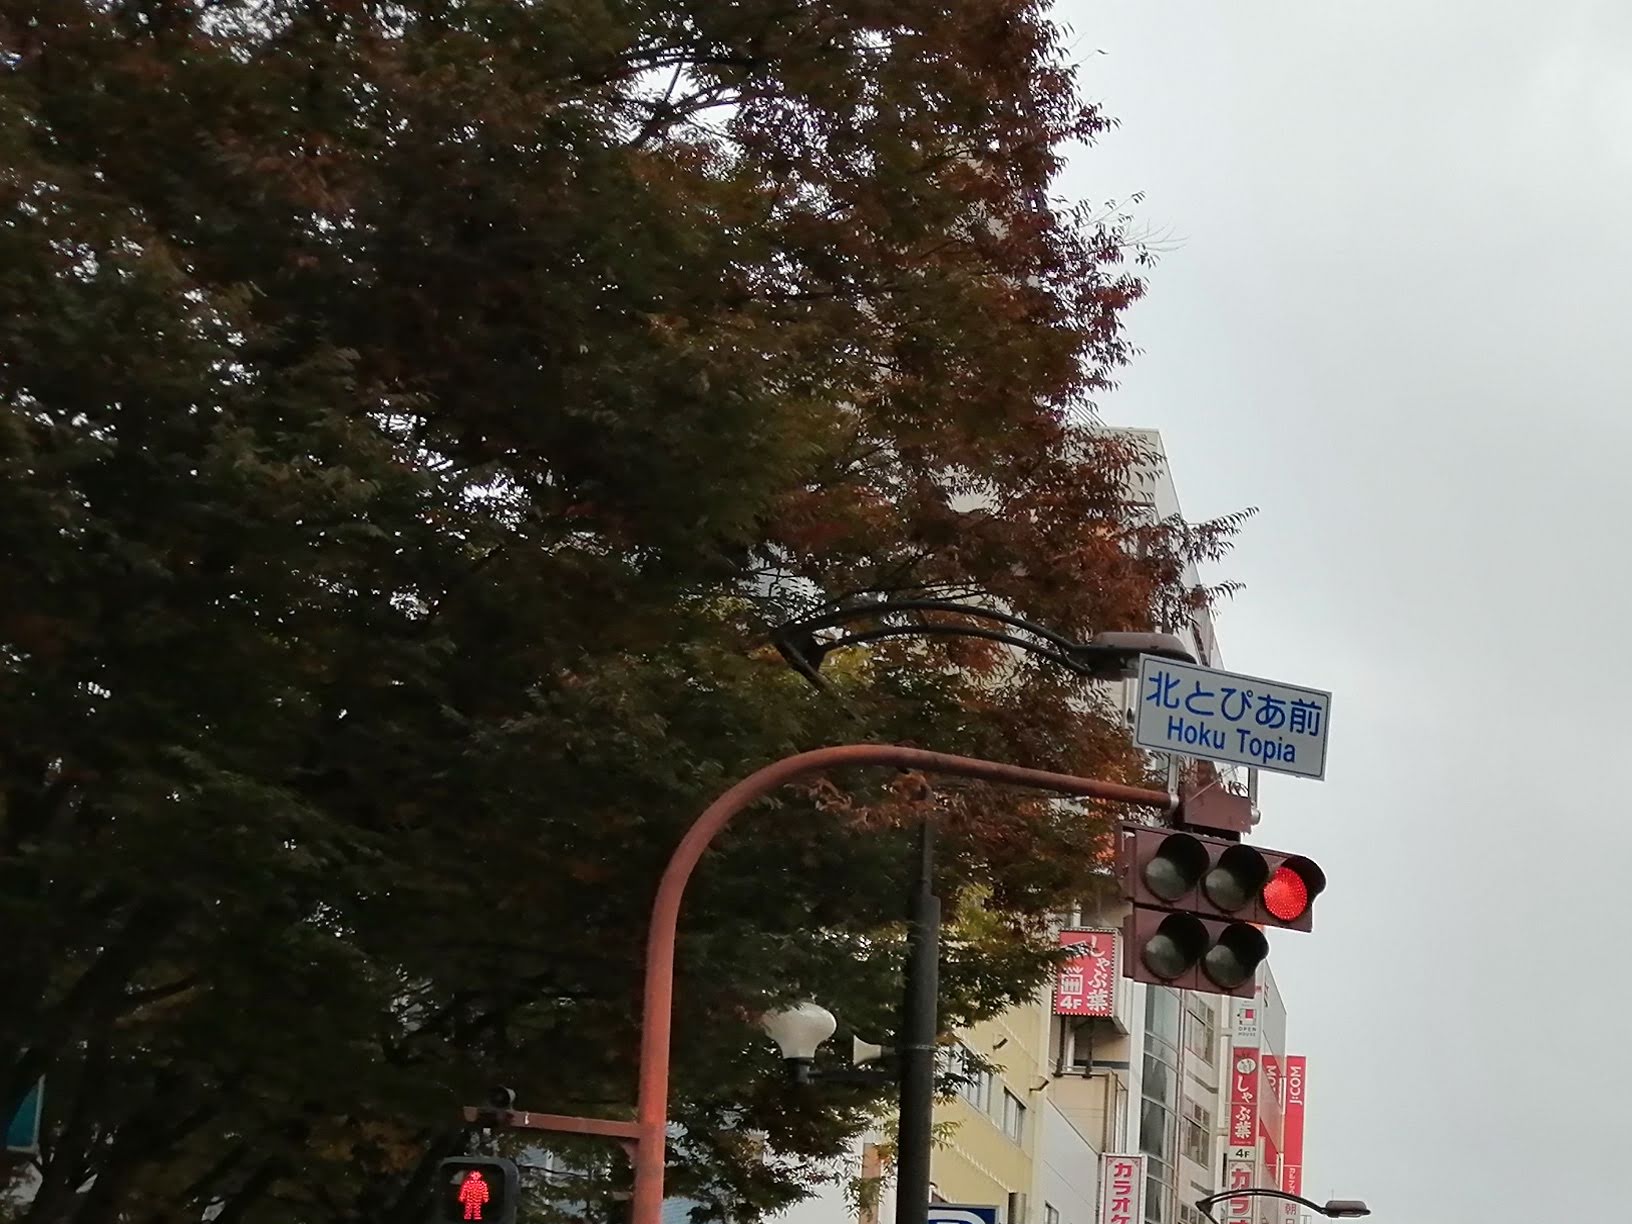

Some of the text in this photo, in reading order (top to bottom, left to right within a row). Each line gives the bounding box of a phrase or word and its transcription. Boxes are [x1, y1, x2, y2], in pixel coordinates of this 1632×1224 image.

[1146, 671, 1322, 737] 北とぴあ前
[1167, 715, 1296, 764] Hoku Topia
[1088, 935, 1110, 1012] しゃぶ葉
[1060, 996, 1082, 1010] 4F
[1234, 1075, 1254, 1139] しゃぶ葉
[1289, 1065, 1302, 1106] J:COM
[1235, 1148, 1250, 1158] 4F
